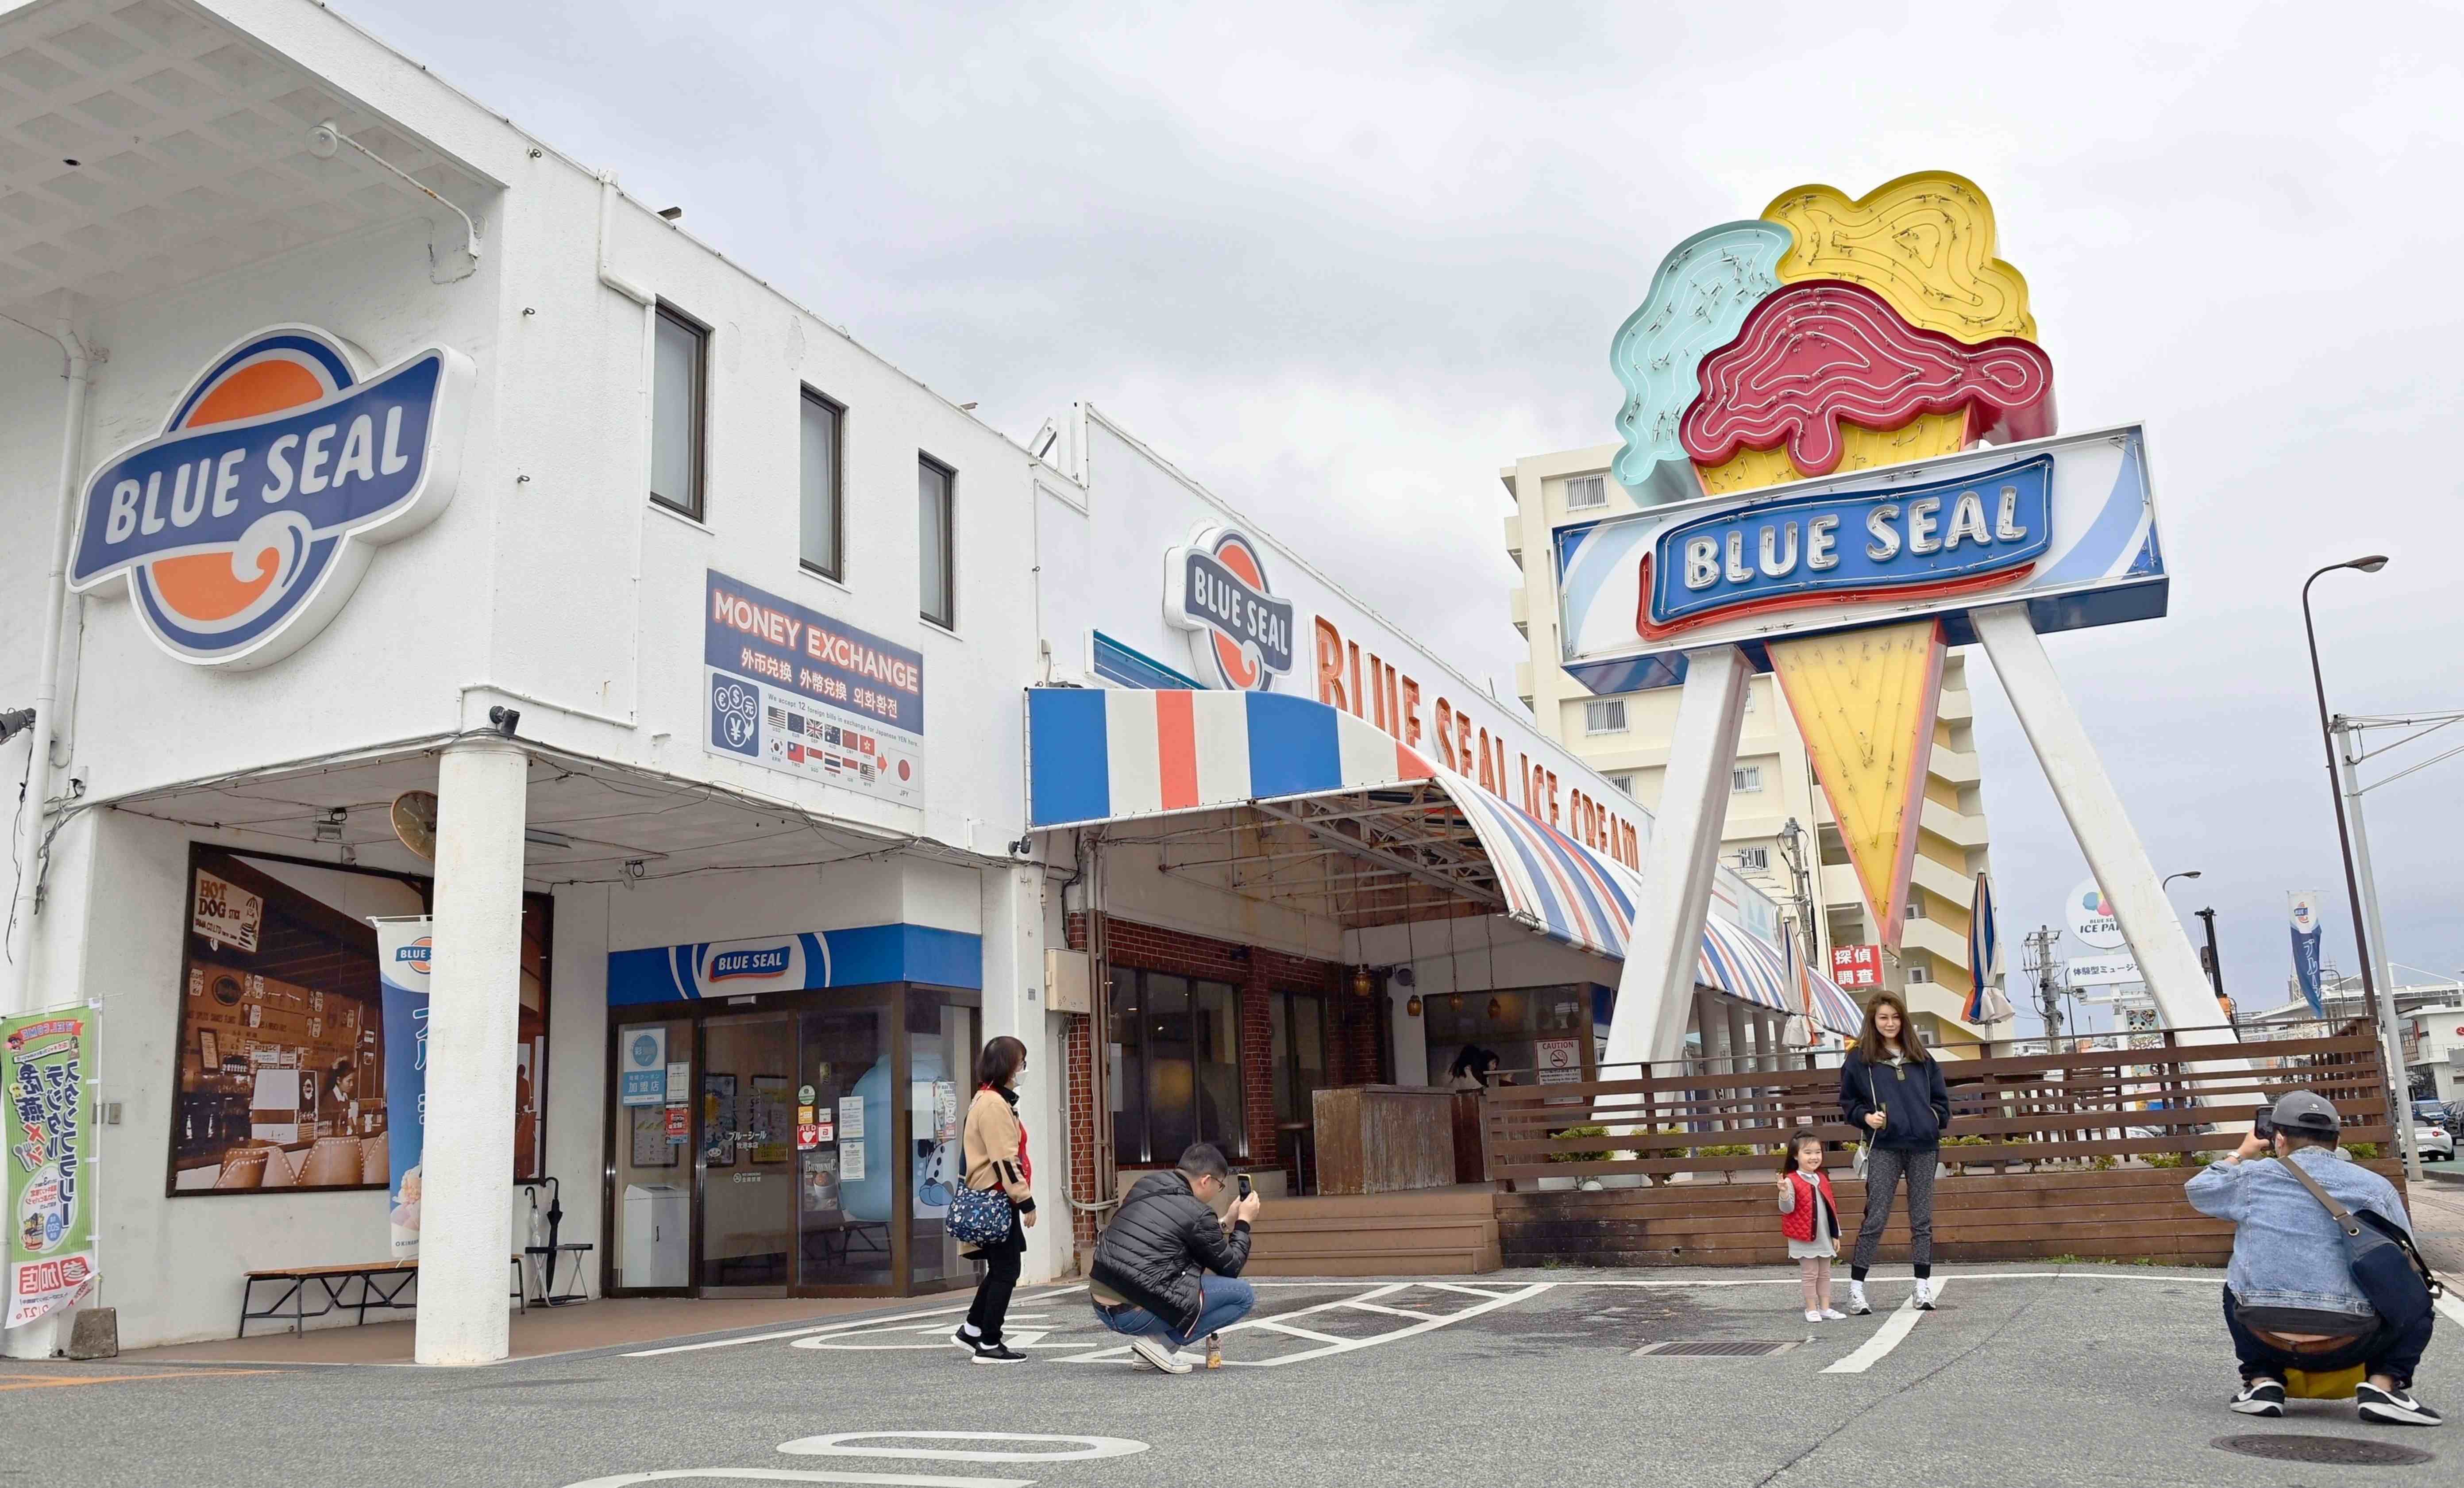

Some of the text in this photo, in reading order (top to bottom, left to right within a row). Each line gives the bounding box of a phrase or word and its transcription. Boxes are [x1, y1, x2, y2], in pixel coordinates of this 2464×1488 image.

[105, 406, 408, 545] BLUE SEAL
[1685, 486, 2028, 591] BLUE SEAL
[1195, 566, 1288, 655] BLUE SEAL
[715, 592, 918, 692] MONEY EXCHANGE
[854, 688, 897, 718] 외화환전
[779, 698, 796, 707] accept
[798, 701, 806, 710] 12
[807, 706, 825, 717] foreign
[826, 711, 836, 720] bills
[844, 719, 866, 731] exchange
[875, 728, 896, 740] Japanese
[201, 880, 227, 900] HOT
[199, 898, 226, 918] DOG
[2080, 925, 2098, 933] ICE
[401, 950, 426, 958] BLUE
[718, 953, 782, 970] BLUE SEAL
[1835, 948, 1871, 965] 探偵
[1837, 969, 1874, 985] 調査
[628, 1081, 659, 1093] 加盟店
[728, 1130, 767, 1142] ブルーシール
[806, 1159, 836, 1172] BROWNIE
